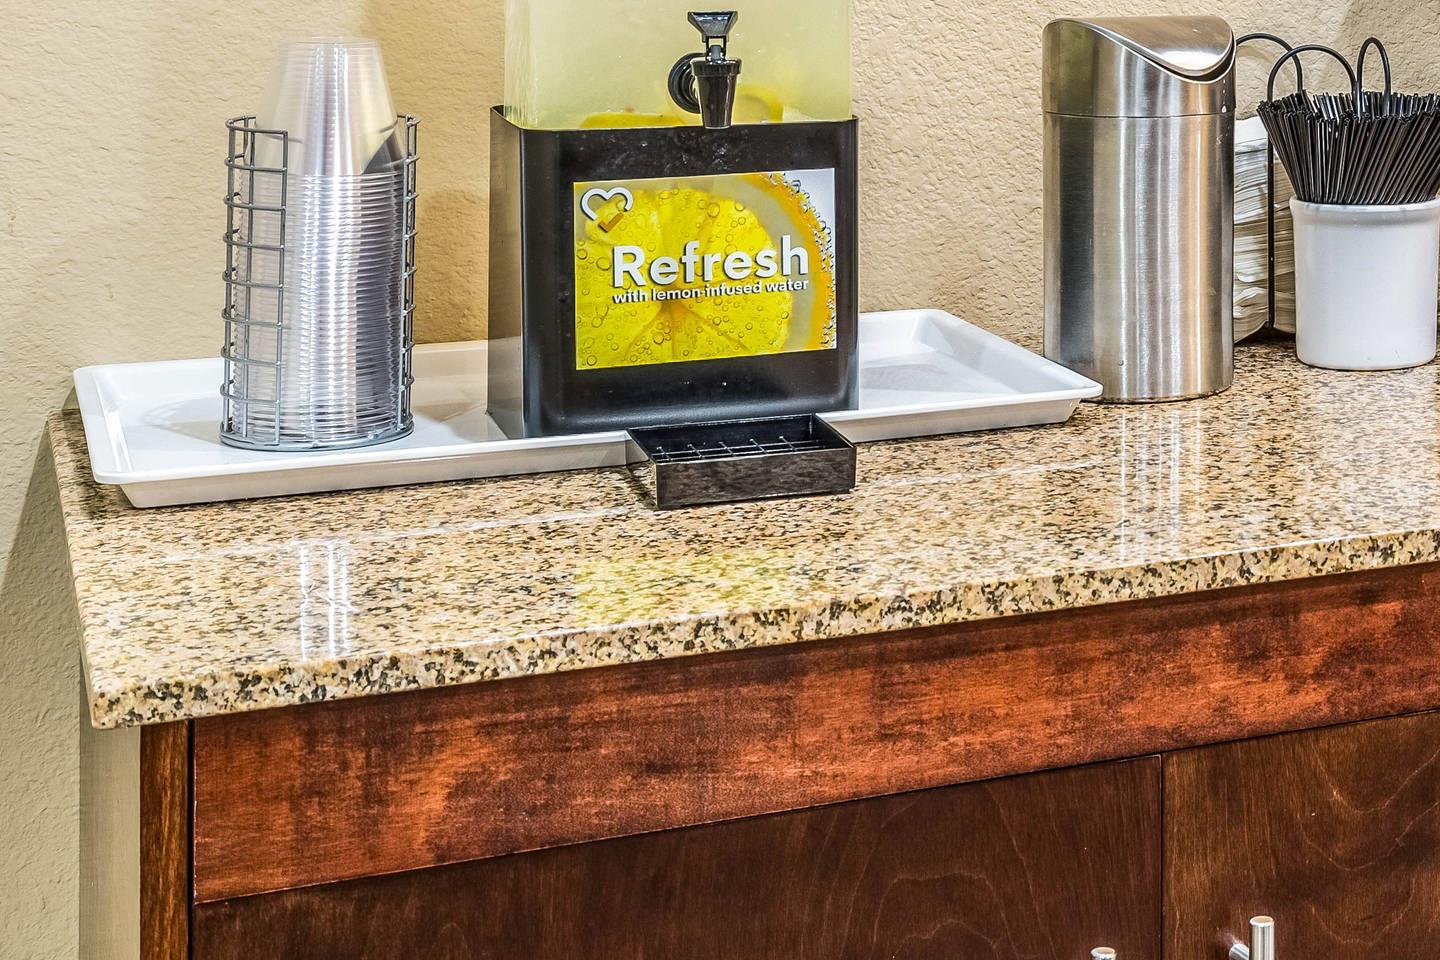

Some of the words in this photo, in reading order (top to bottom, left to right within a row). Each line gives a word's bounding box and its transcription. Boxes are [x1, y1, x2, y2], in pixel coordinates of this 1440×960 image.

[612, 234, 809, 288] Refresh
[613, 287, 649, 304] with
[763, 279, 809, 293] water
